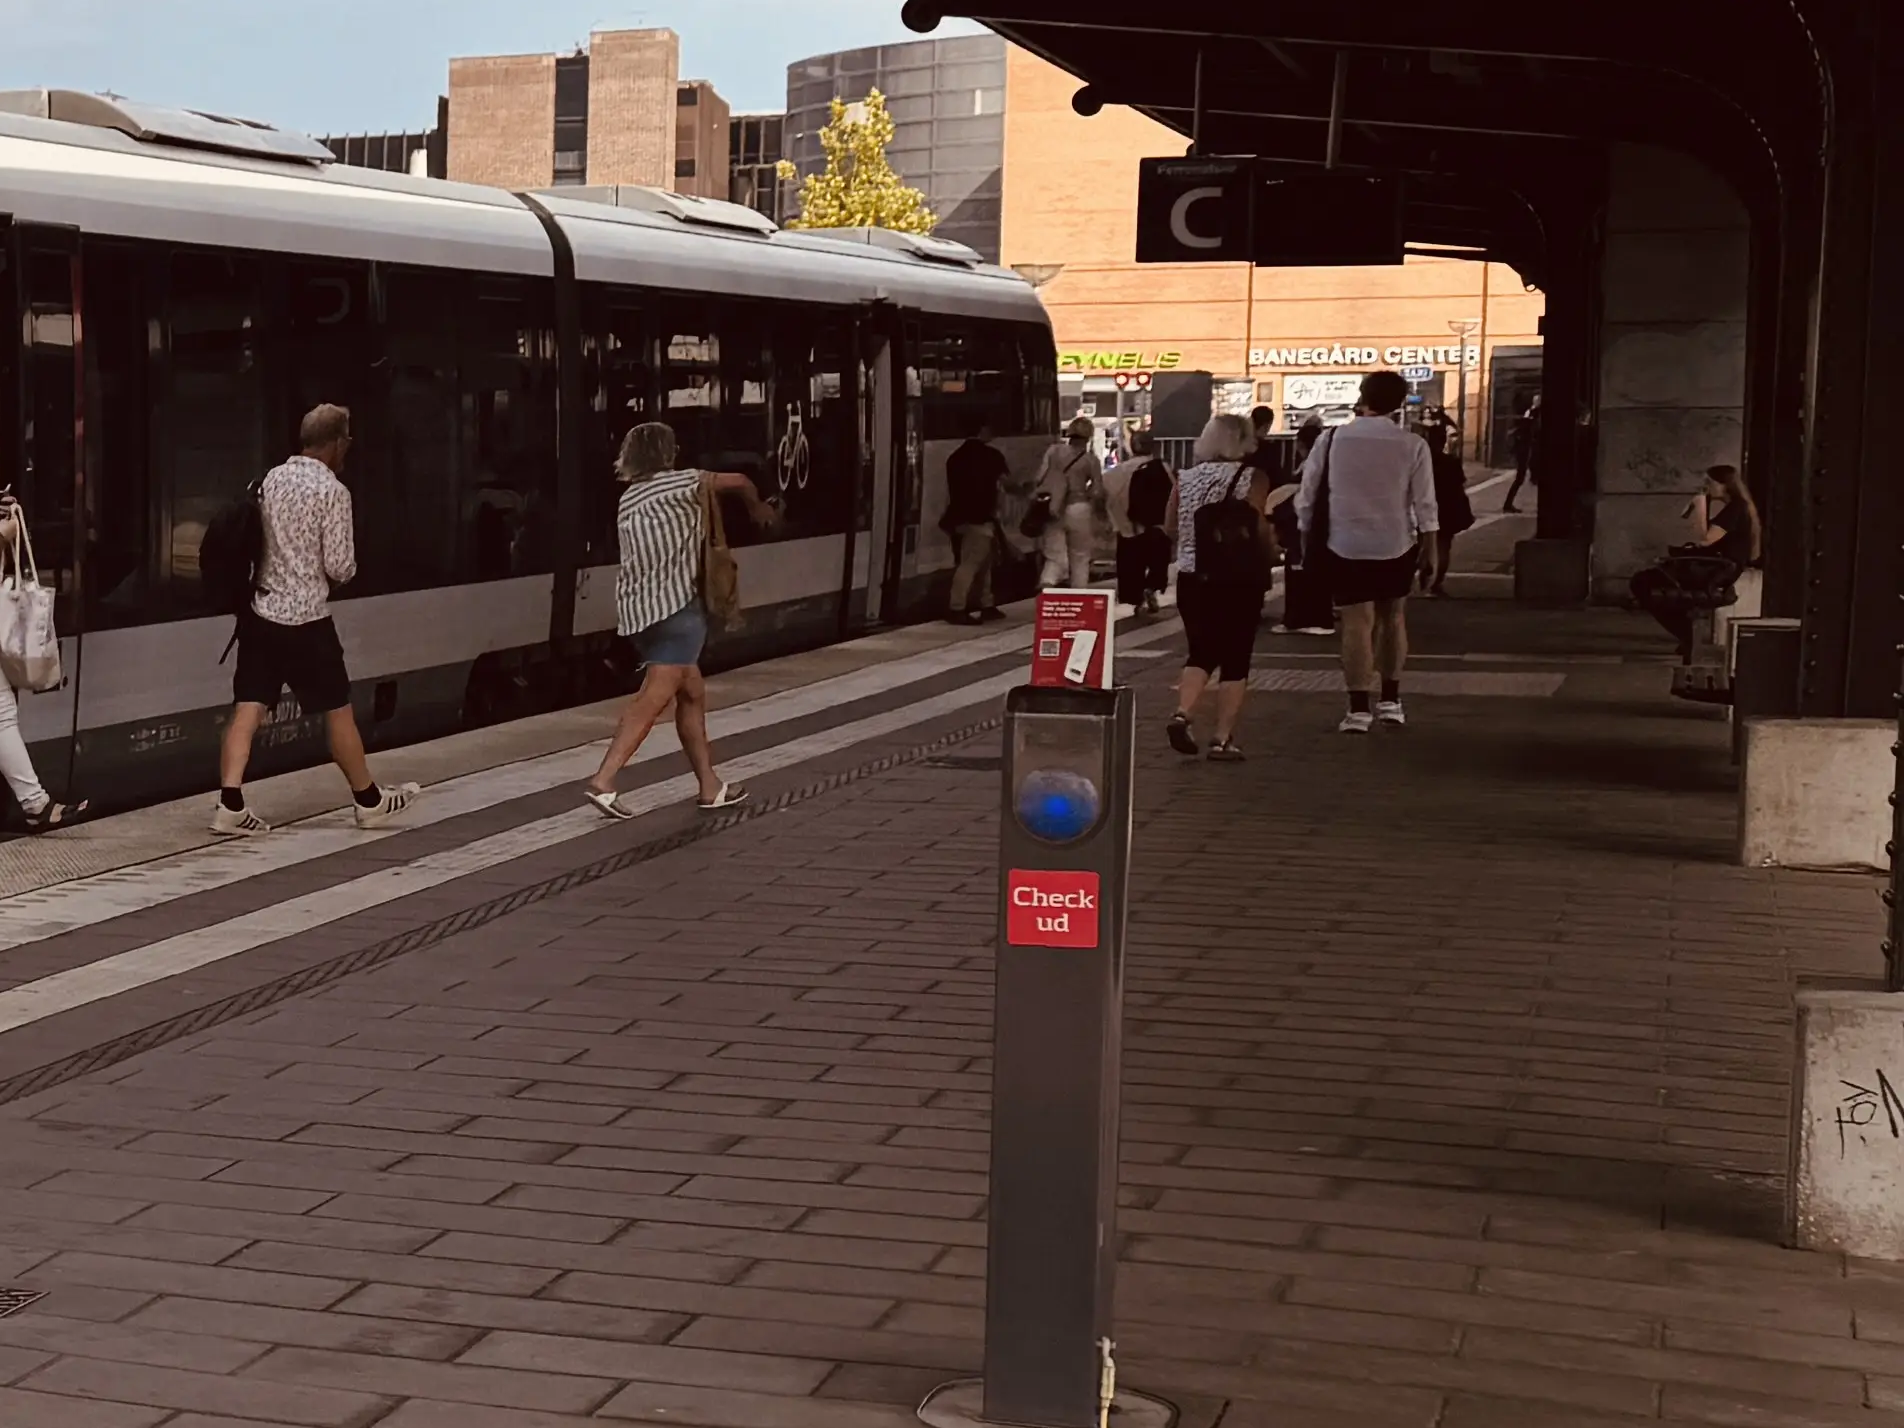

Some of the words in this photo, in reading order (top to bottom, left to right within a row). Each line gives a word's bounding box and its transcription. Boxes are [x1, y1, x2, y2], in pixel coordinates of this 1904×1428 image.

[1169, 186, 1224, 249] C
[1248, 343, 1379, 366] BANEGÅRD
[1384, 345, 1481, 367] CENTER
[1013, 886, 1095, 909] Check
[1036, 913, 1070, 933] ud
